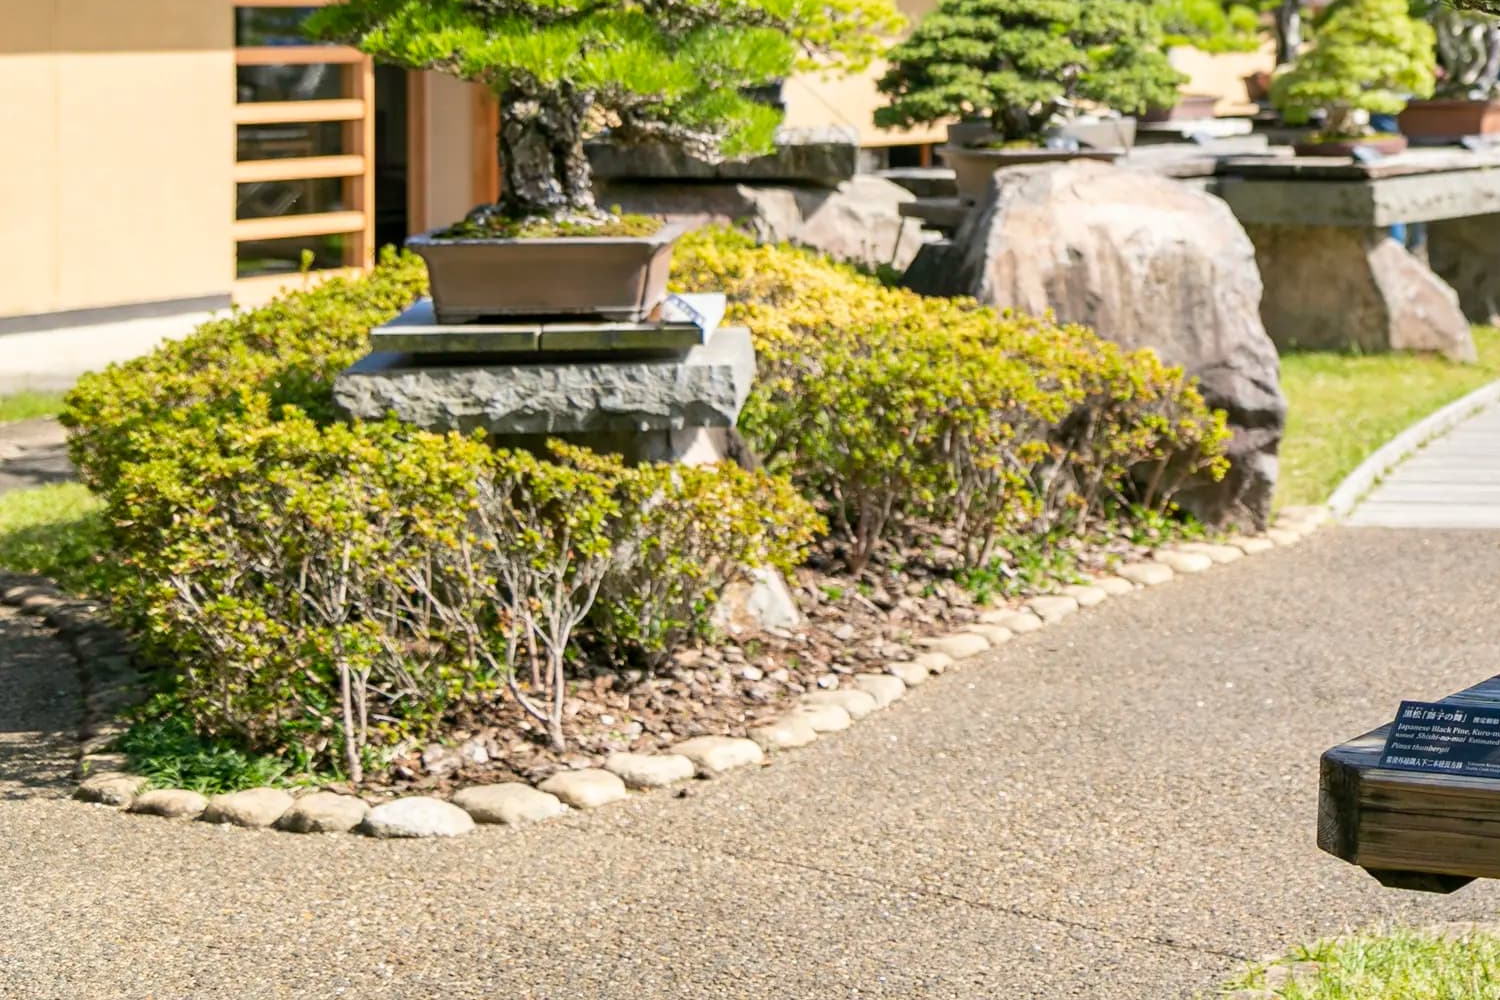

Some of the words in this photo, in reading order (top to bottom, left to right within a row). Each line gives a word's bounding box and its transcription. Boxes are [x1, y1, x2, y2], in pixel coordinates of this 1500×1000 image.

[1398, 723, 1430, 731] Japanese
[1432, 725, 1452, 733] Black
[1453, 727, 1471, 735] Pine,
[1469, 737, 1500, 745] Estimated
[1391, 742, 1411, 750] Pinus
[1412, 744, 1450, 753] thunbergii
